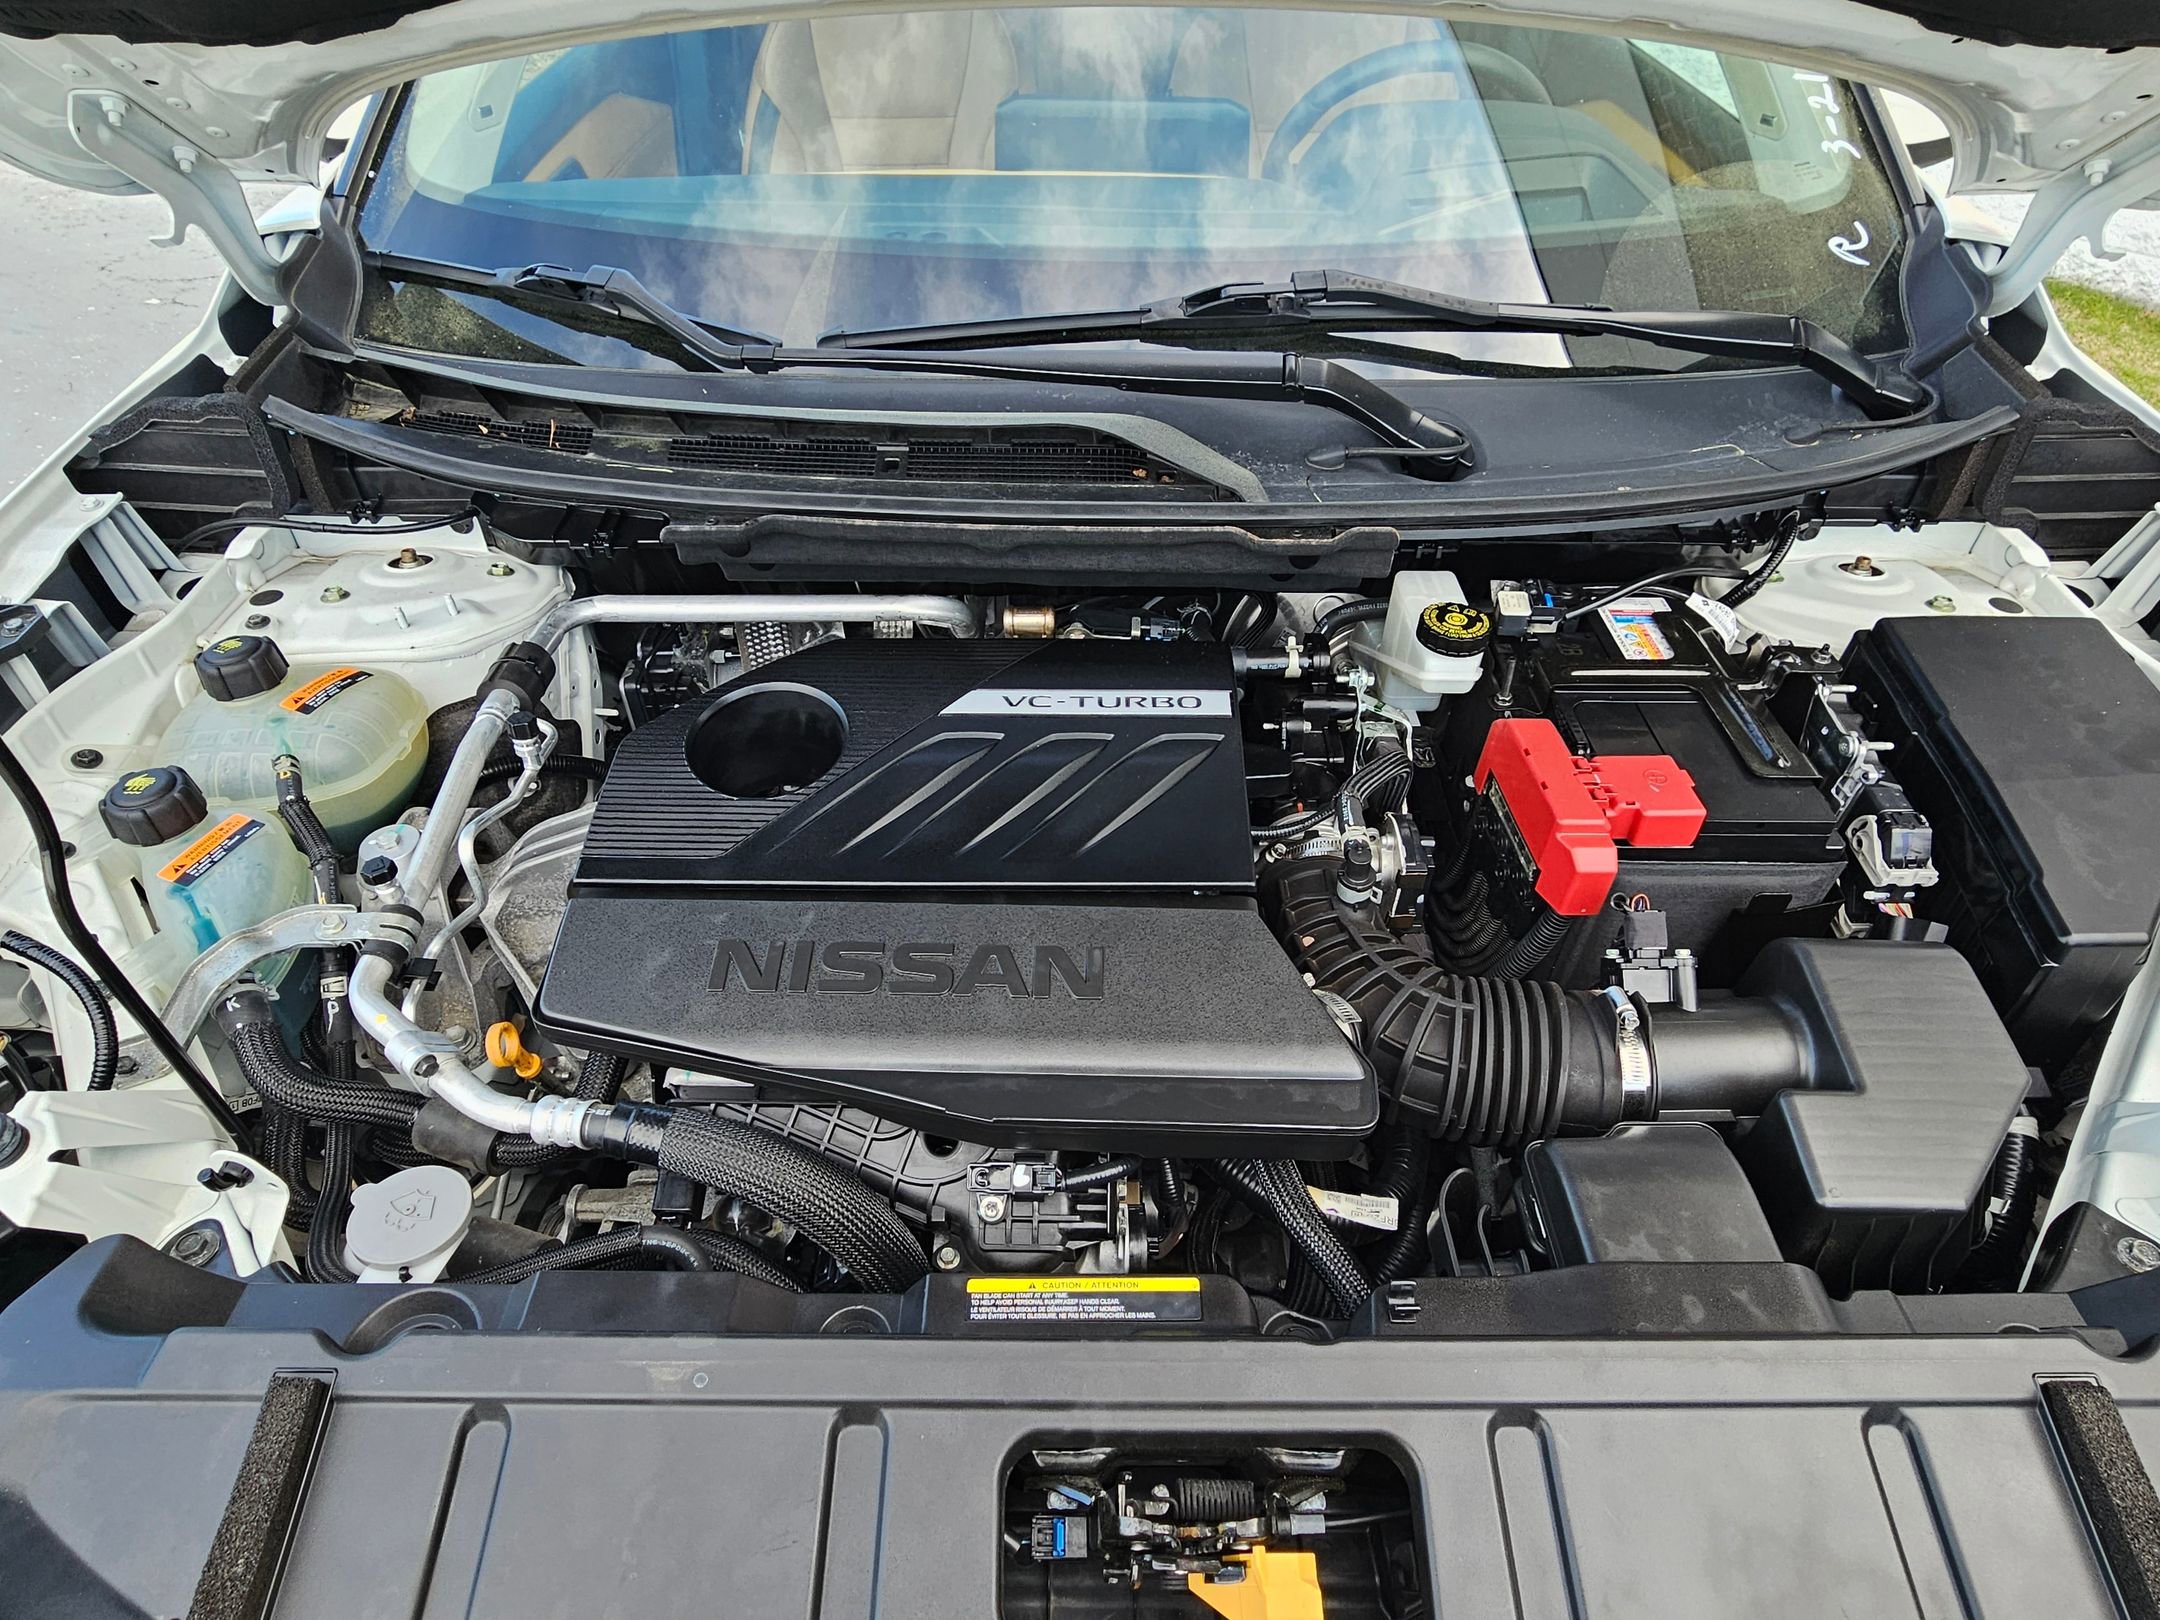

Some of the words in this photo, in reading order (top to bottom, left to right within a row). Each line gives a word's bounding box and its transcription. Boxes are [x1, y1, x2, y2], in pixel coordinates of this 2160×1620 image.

[1828, 220, 1870, 267] R
[1002, 695, 1203, 708] VC-TURBO
[707, 938, 1105, 1000] NISSAN
